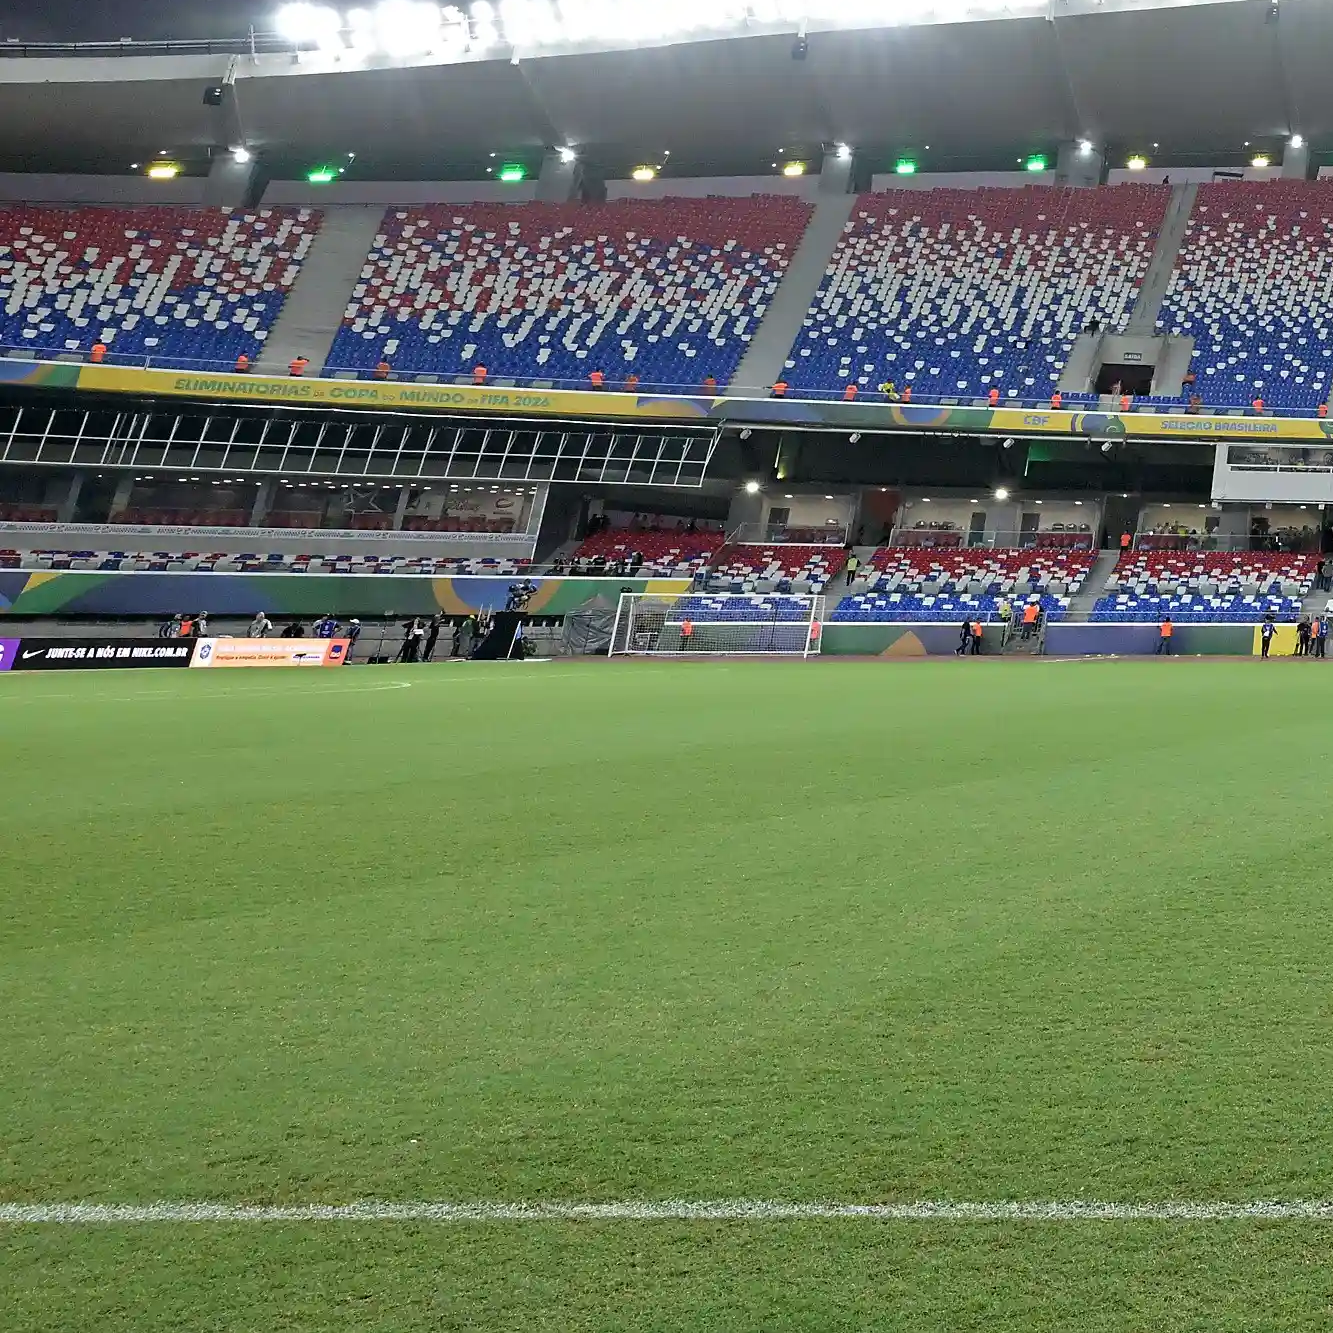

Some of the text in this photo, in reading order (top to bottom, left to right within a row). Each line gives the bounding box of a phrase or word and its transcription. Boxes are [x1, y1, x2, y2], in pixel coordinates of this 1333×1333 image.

[329, 387, 379, 400] COPA
[399, 391, 465, 404] MUNDO
[479, 393, 509, 406] FIFA
[513, 395, 551, 407] 2026
[1023, 415, 1050, 426] CBF
[1214, 423, 1278, 433] BRASILEIRA
[45, 645, 188, 659] JUNTE-SE A NÓS EM NIKE.COM.BR
